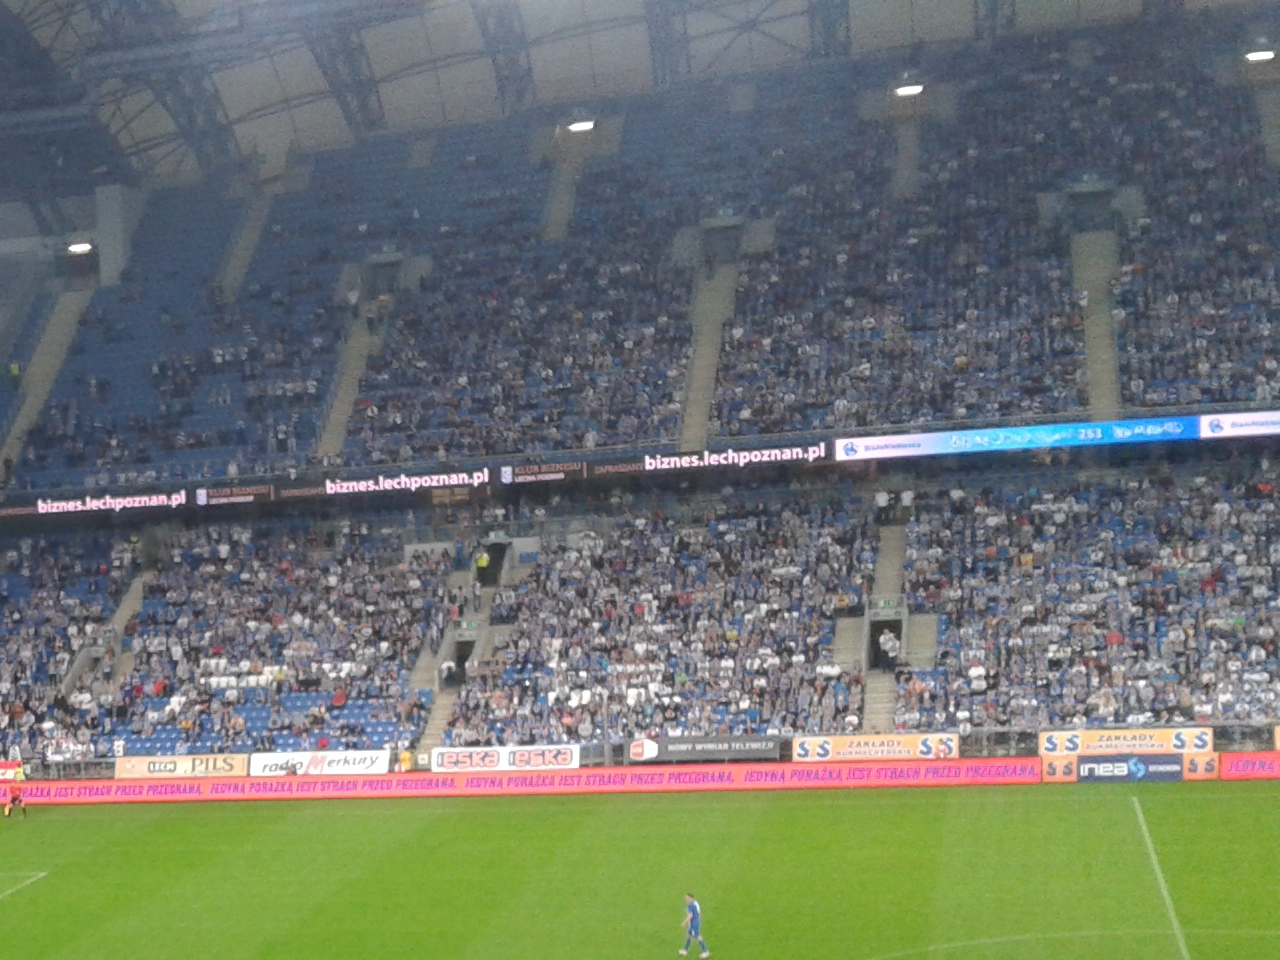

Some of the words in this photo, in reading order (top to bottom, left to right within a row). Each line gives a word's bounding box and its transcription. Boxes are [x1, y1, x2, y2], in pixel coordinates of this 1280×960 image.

[645, 442, 825, 471] biznes.lechpoznan.pl
[325, 467, 489, 495] biznes.lechpoznan.pl
[37, 489, 186, 516] biznes.lechpoznan.pl
[149, 762, 176, 772] LECH
[191, 756, 235, 774] PILS
[304, 752, 379, 774] Merkury
[1080, 762, 1129, 777] inea
